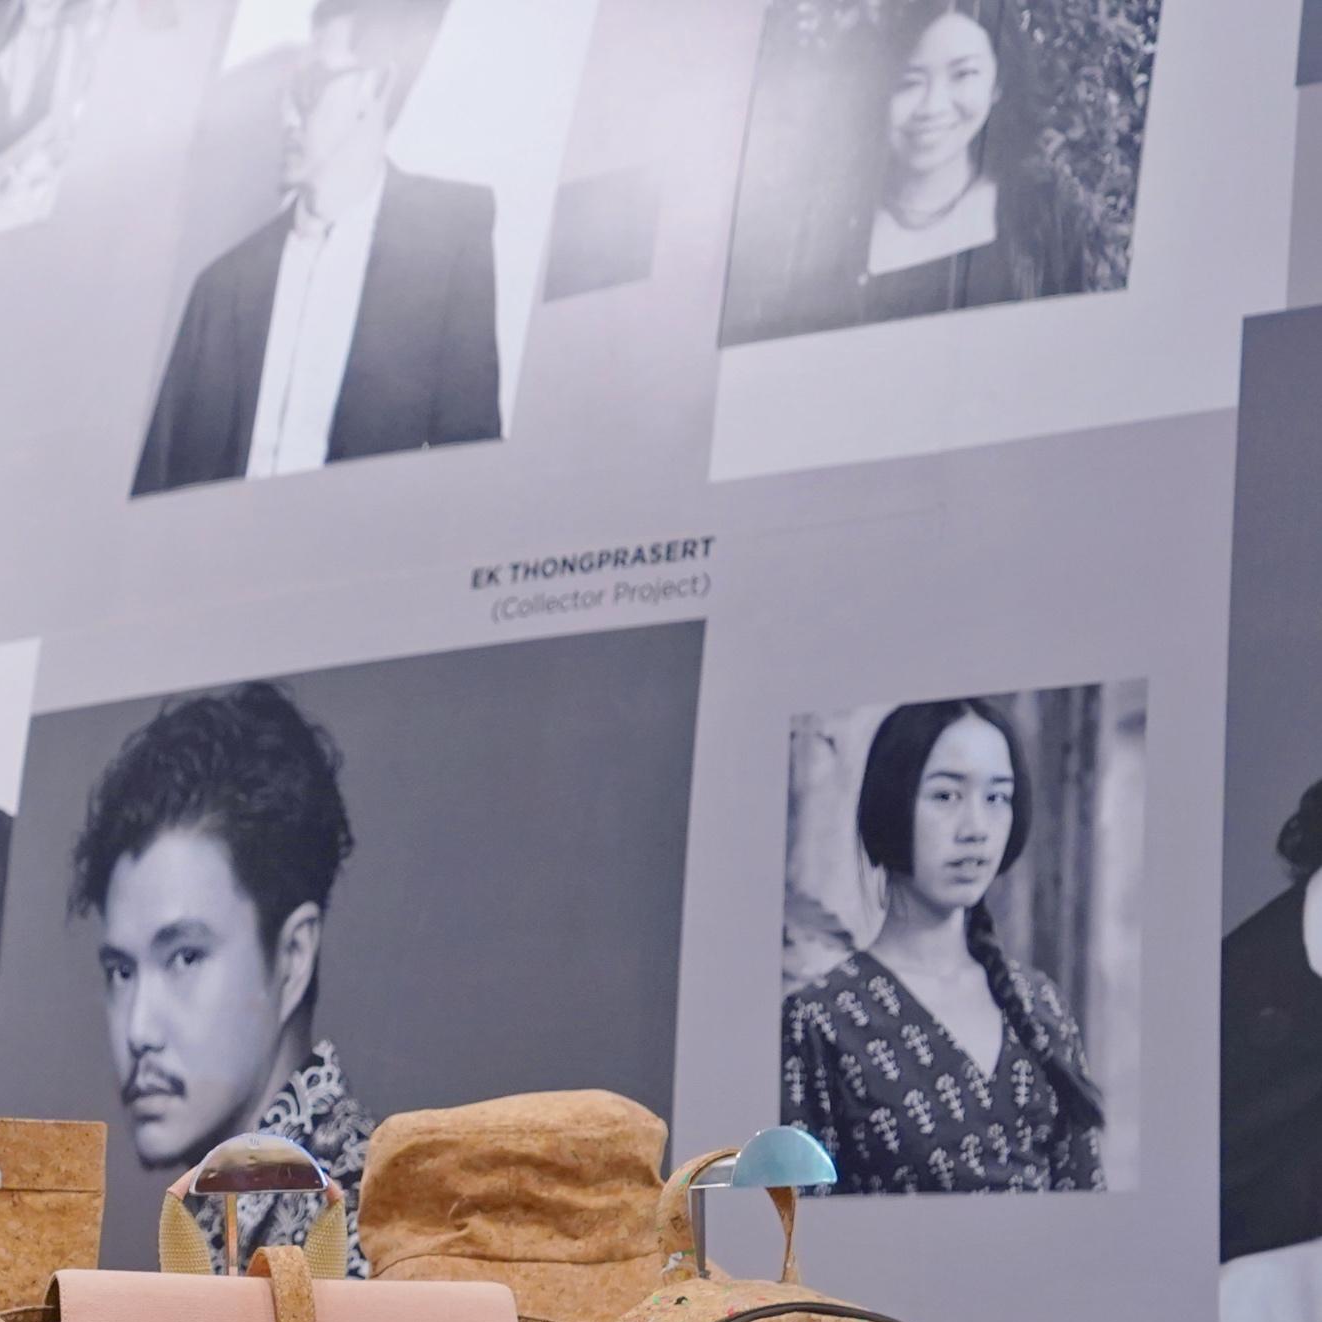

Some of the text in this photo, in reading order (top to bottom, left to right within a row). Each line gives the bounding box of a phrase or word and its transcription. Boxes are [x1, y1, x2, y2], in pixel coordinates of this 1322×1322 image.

[471, 535, 717, 590] EK THONGPRASERT
[491, 571, 712, 624] (Collector Project)
